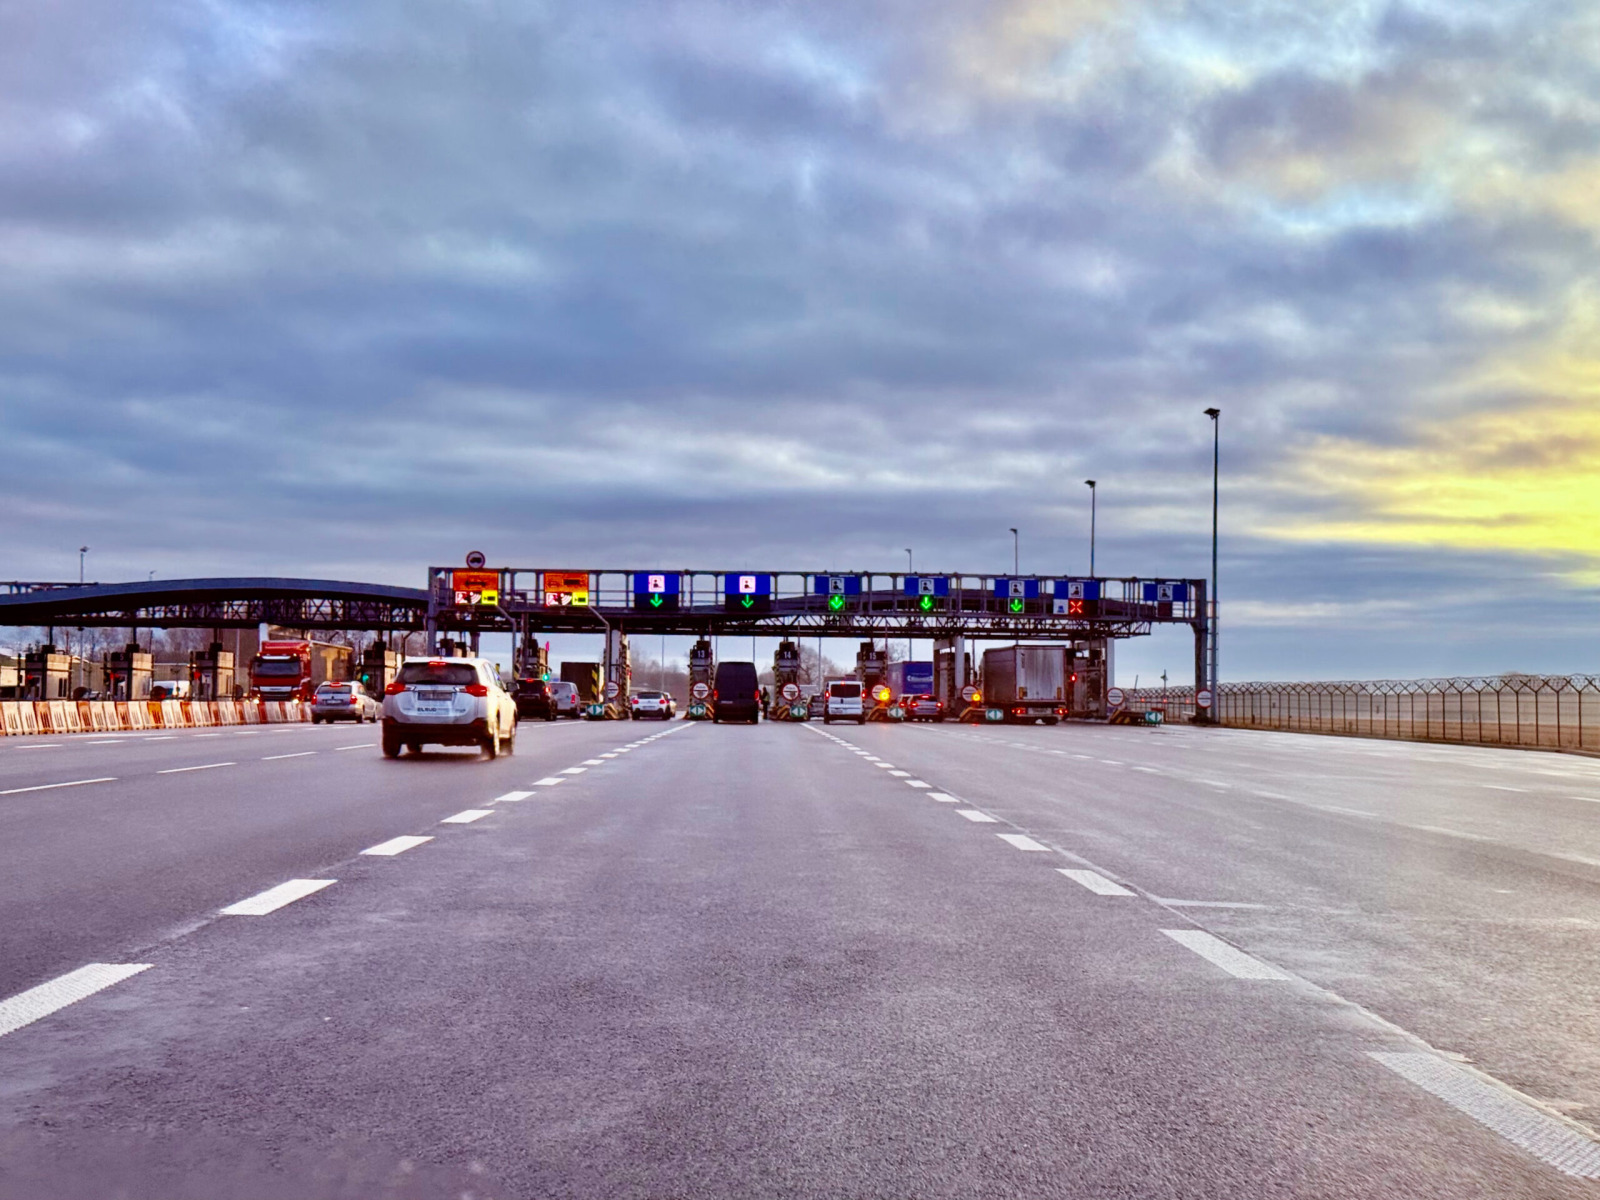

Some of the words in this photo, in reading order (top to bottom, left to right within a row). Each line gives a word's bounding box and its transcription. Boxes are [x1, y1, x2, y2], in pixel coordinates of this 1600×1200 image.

[697, 650, 705, 658] 13
[784, 651, 792, 659] 14
[869, 652, 877, 660] 15
